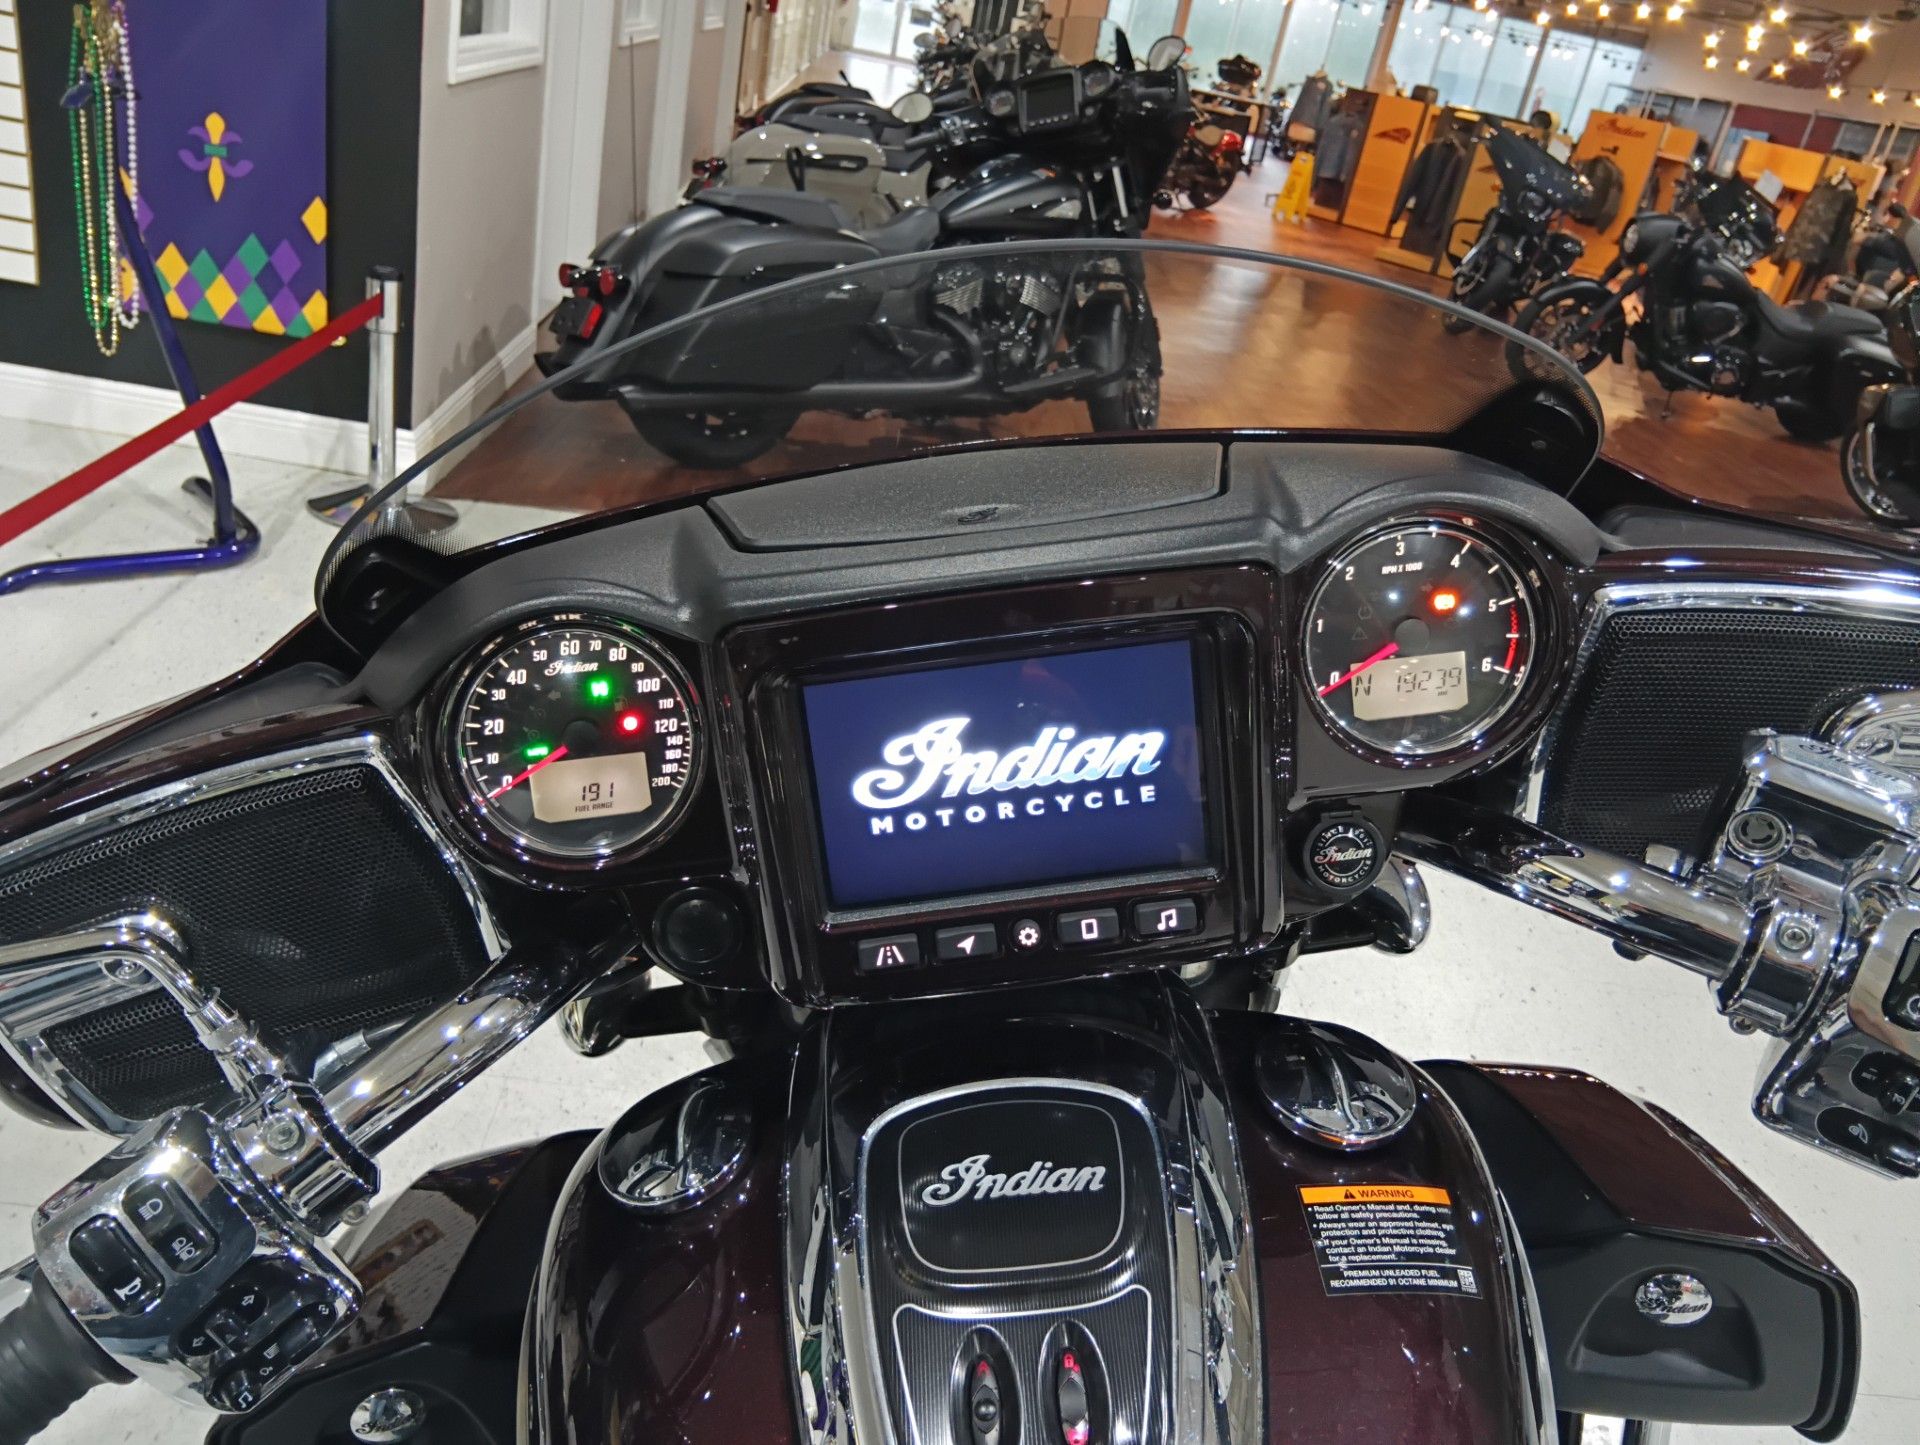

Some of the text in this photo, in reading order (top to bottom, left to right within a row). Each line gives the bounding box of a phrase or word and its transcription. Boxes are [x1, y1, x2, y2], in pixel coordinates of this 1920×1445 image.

[1395, 541, 1405, 556] 3
[1405, 562, 1423, 572] 1000
[1450, 554, 1461, 568] 4
[1345, 567, 1355, 581] 2
[1488, 599, 1497, 612] 5
[1316, 619, 1323, 633] 1
[560, 640, 580, 655] 60
[589, 640, 602, 651] 70
[533, 650, 547, 662] 50
[609, 647, 627, 661] 80
[544, 660, 598, 676] Indian
[631, 662, 644, 673] 90
[1481, 658, 1491, 672] 6
[506, 669, 527, 685] 40
[1330, 671, 1340, 685] 0
[637, 678, 660, 693] 100
[1354, 674, 1372, 697] N
[491, 689, 506, 701] 30
[658, 698, 674, 709] 110
[484, 719, 504, 735] 20
[655, 718, 678, 734] 120
[667, 735, 683, 746] 140
[487, 753, 499, 764] 10
[665, 748, 682, 760] 160
[662, 763, 678, 774] 180
[852, 717, 1165, 809] Indian
[502, 775, 513, 790] 0
[652, 777, 671, 787] 200
[581, 782, 615, 802] 191
[575, 801, 613, 813] FUEL RANGE
[870, 784, 1157, 836] MOTORCYCLE
[1314, 846, 1372, 864] Indian
[1318, 859, 1372, 884] MOTORCYCLE
[922, 1154, 1106, 1207] Indian
[1358, 1189, 1414, 1199] WARNING
[1335, 1204, 1366, 1212] Owner's
[1413, 1205, 1436, 1214] during
[1351, 1212, 1374, 1220] safety
[1375, 1212, 1420, 1220] precautions.
[1319, 1222, 1347, 1230] Always
[1379, 1221, 1414, 1230] approved
[1321, 1229, 1360, 1238] protection
[1378, 1228, 1415, 1237] protective
[1331, 1239, 1348, 1247] your
[1326, 1246, 1356, 1254] contact
[1368, 1245, 1392, 1253] Indian
[1393, 1245, 1434, 1254] Motorcycle
[1435, 1247, 1457, 1255] dealer
[1348, 1254, 1399, 1262] replacement.
[1343, 1270, 1380, 1278] PREMIUM
[1421, 1270, 1440, 1278] FUEL
[1329, 1279, 1388, 1288] RECOMMENDED
[1398, 1278, 1428, 1286] OCTANE
[1428, 1279, 1459, 1288] MINIMUM
